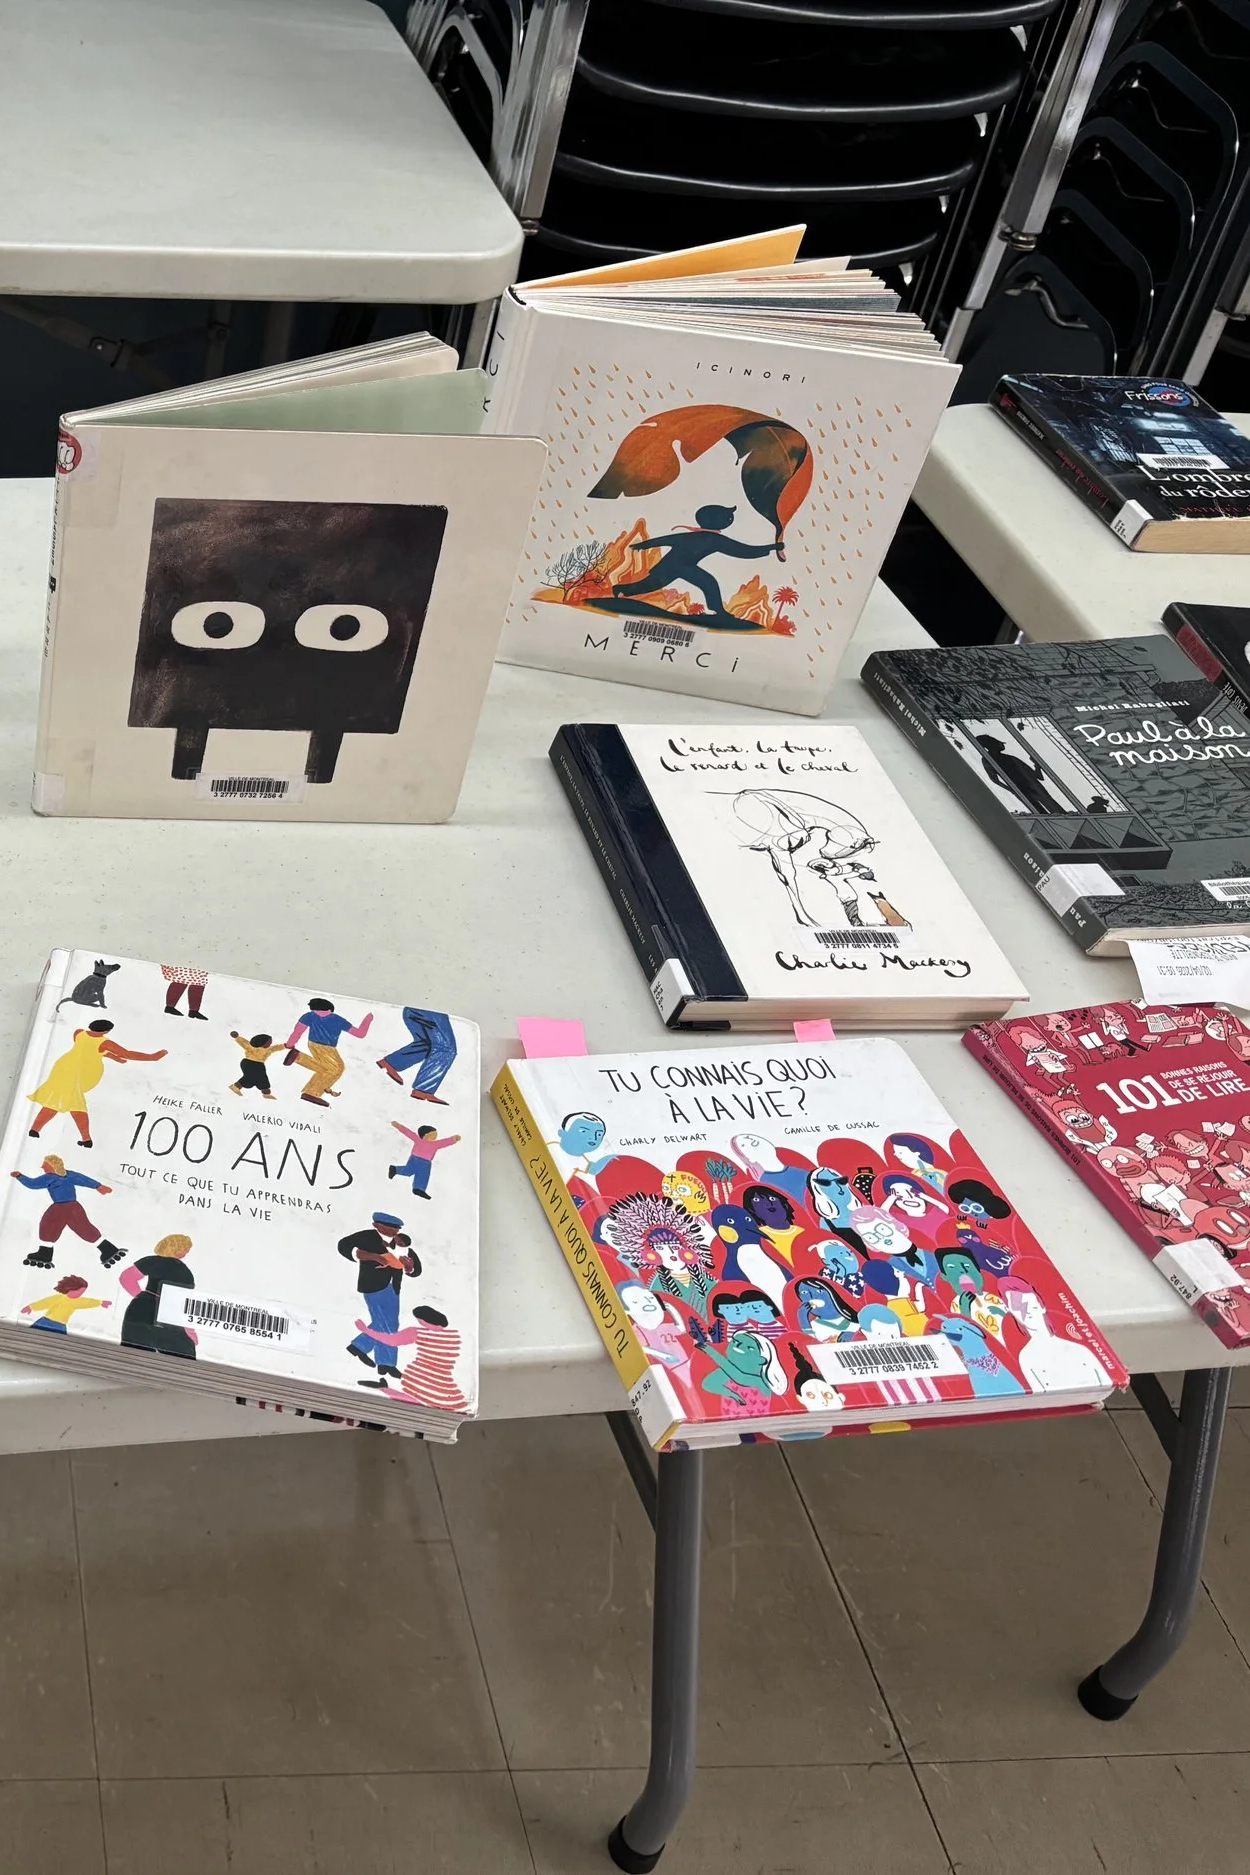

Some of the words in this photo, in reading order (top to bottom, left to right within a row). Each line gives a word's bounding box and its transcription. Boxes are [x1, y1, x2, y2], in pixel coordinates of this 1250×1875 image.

[696, 362, 805, 383] ICINORI
[1124, 390, 1184, 401] Frissons
[1159, 485, 1183, 497] du
[1184, 484, 1250, 498] rôde
[629, 633, 646, 641] 2777
[1074, 703, 1121, 712] Michel
[1121, 700, 1191, 710] Rabagliati
[1073, 720, 1172, 747] Paul
[1168, 720, 1200, 740] à
[1196, 716, 1246, 739] la
[1109, 743, 1250, 766] maison
[690, 760, 748, 772] renard
[755, 761, 769, 770] et
[801, 761, 859, 773] cheval
[1023, 852, 1045, 878] aison
[1037, 875, 1051, 891] PAU
[1070, 906, 1087, 928] Pau
[775, 950, 868, 971] Charlie
[598, 1069, 642, 1093] TU
[1096, 1075, 1182, 1114] 101
[1159, 1067, 1194, 1080] BONNES
[1193, 1061, 1228, 1074] RAISONS
[1168, 1078, 1184, 1089] DE
[1183, 1076, 1198, 1086] SE
[1197, 1069, 1237, 1084] RÉJOUIR
[1176, 1086, 1208, 1103] DE
[1205, 1078, 1250, 1097] LIRE
[152, 1094, 184, 1108] HEIKE
[189, 1101, 223, 1116] FALLER
[665, 1092, 691, 1124] À
[693, 1095, 736, 1122] LA
[242, 1112, 283, 1127] VALERIO
[288, 1121, 321, 1134] VIDALI
[827, 1124, 840, 1132] DE
[846, 1121, 880, 1130] CUSSAC
[664, 1133, 708, 1143] DELWART
[129, 1111, 213, 1164] 100
[230, 1131, 356, 1190] ANS
[120, 1162, 157, 1179] TOUT
[163, 1172, 178, 1184] CE
[187, 1176, 214, 1192] QUE
[222, 1182, 239, 1196] TU
[246, 1188, 332, 1214] APPRENDRAS
[179, 1193, 212, 1209] DANS
[223, 1203, 241, 1216] LA
[249, 1207, 272, 1221] VIE
[548, 1192, 566, 1214] LA
[565, 1222, 588, 1258] QUOI
[582, 1261, 618, 1330] CONNAIS
[1057, 1292, 1088, 1327] joachim
[188, 1315, 194, 1323] 3
[197, 1317, 220, 1328] 2777
[223, 1320, 247, 1334] 0765
[249, 1328, 274, 1340] 8554
[277, 1333, 282, 1341] 1
[613, 1328, 630, 1359] TU
[1088, 1339, 1115, 1370] marcel
[859, 1366, 880, 1375] 2777
[883, 1365, 906, 1373] 0839
[909, 1363, 930, 1371] 7452
[932, 1361, 939, 1369] 2
